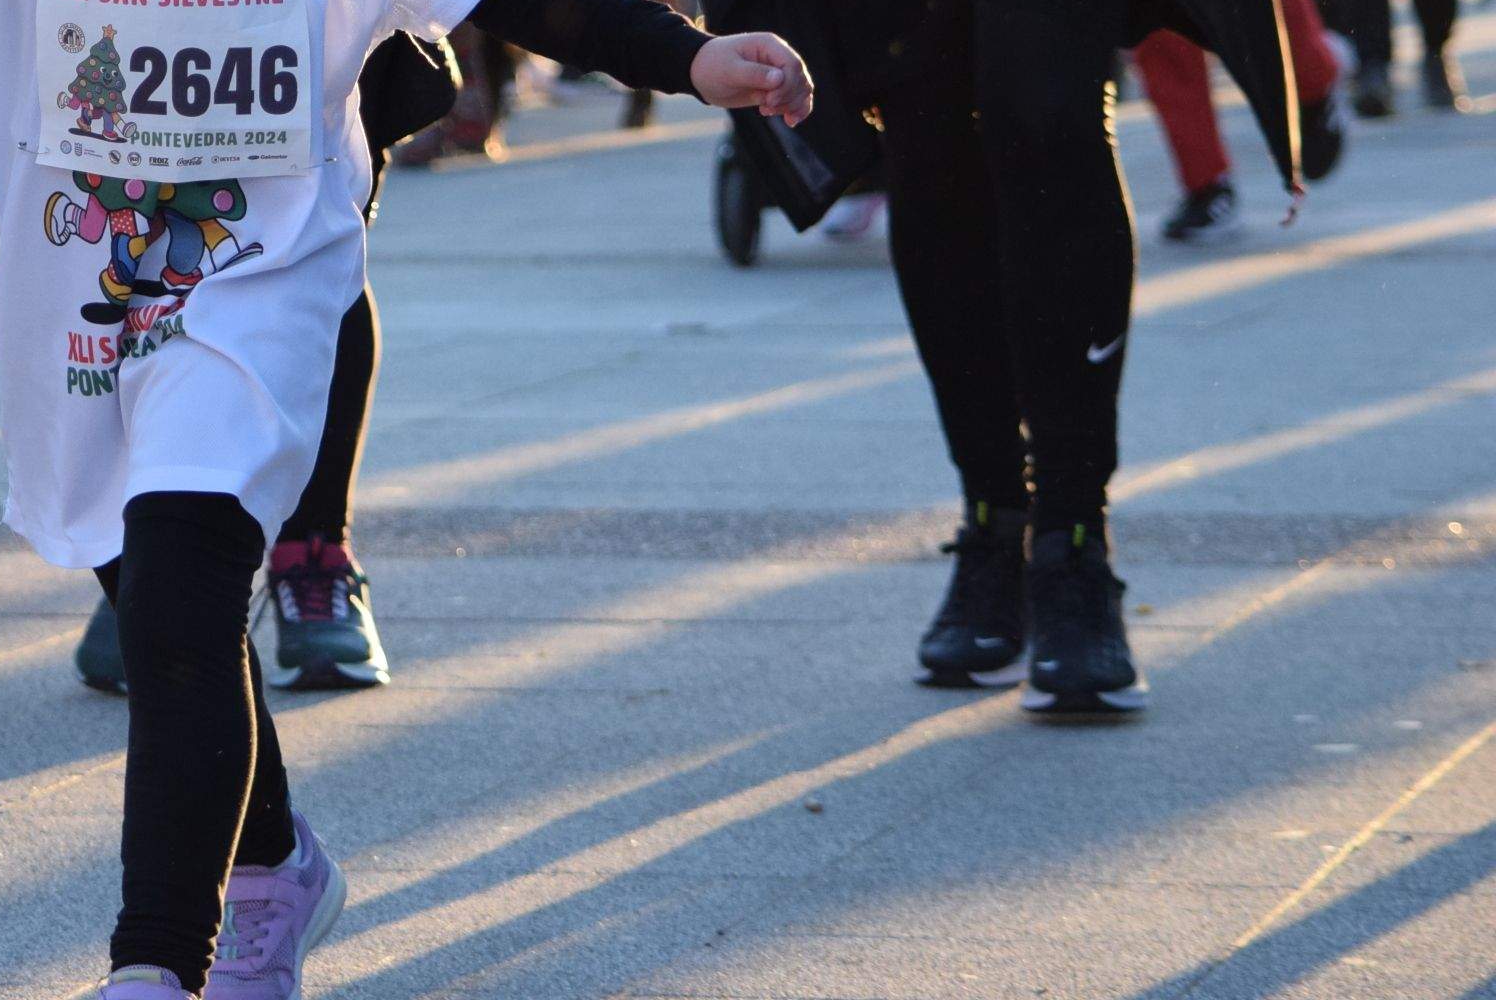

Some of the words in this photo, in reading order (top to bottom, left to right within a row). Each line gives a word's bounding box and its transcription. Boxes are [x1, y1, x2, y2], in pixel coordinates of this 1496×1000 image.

[129, 44, 298, 118] 2646
[130, 130, 238, 149] PONTEVEDRA
[244, 130, 287, 146] 2024
[68, 332, 94, 364] XLI
